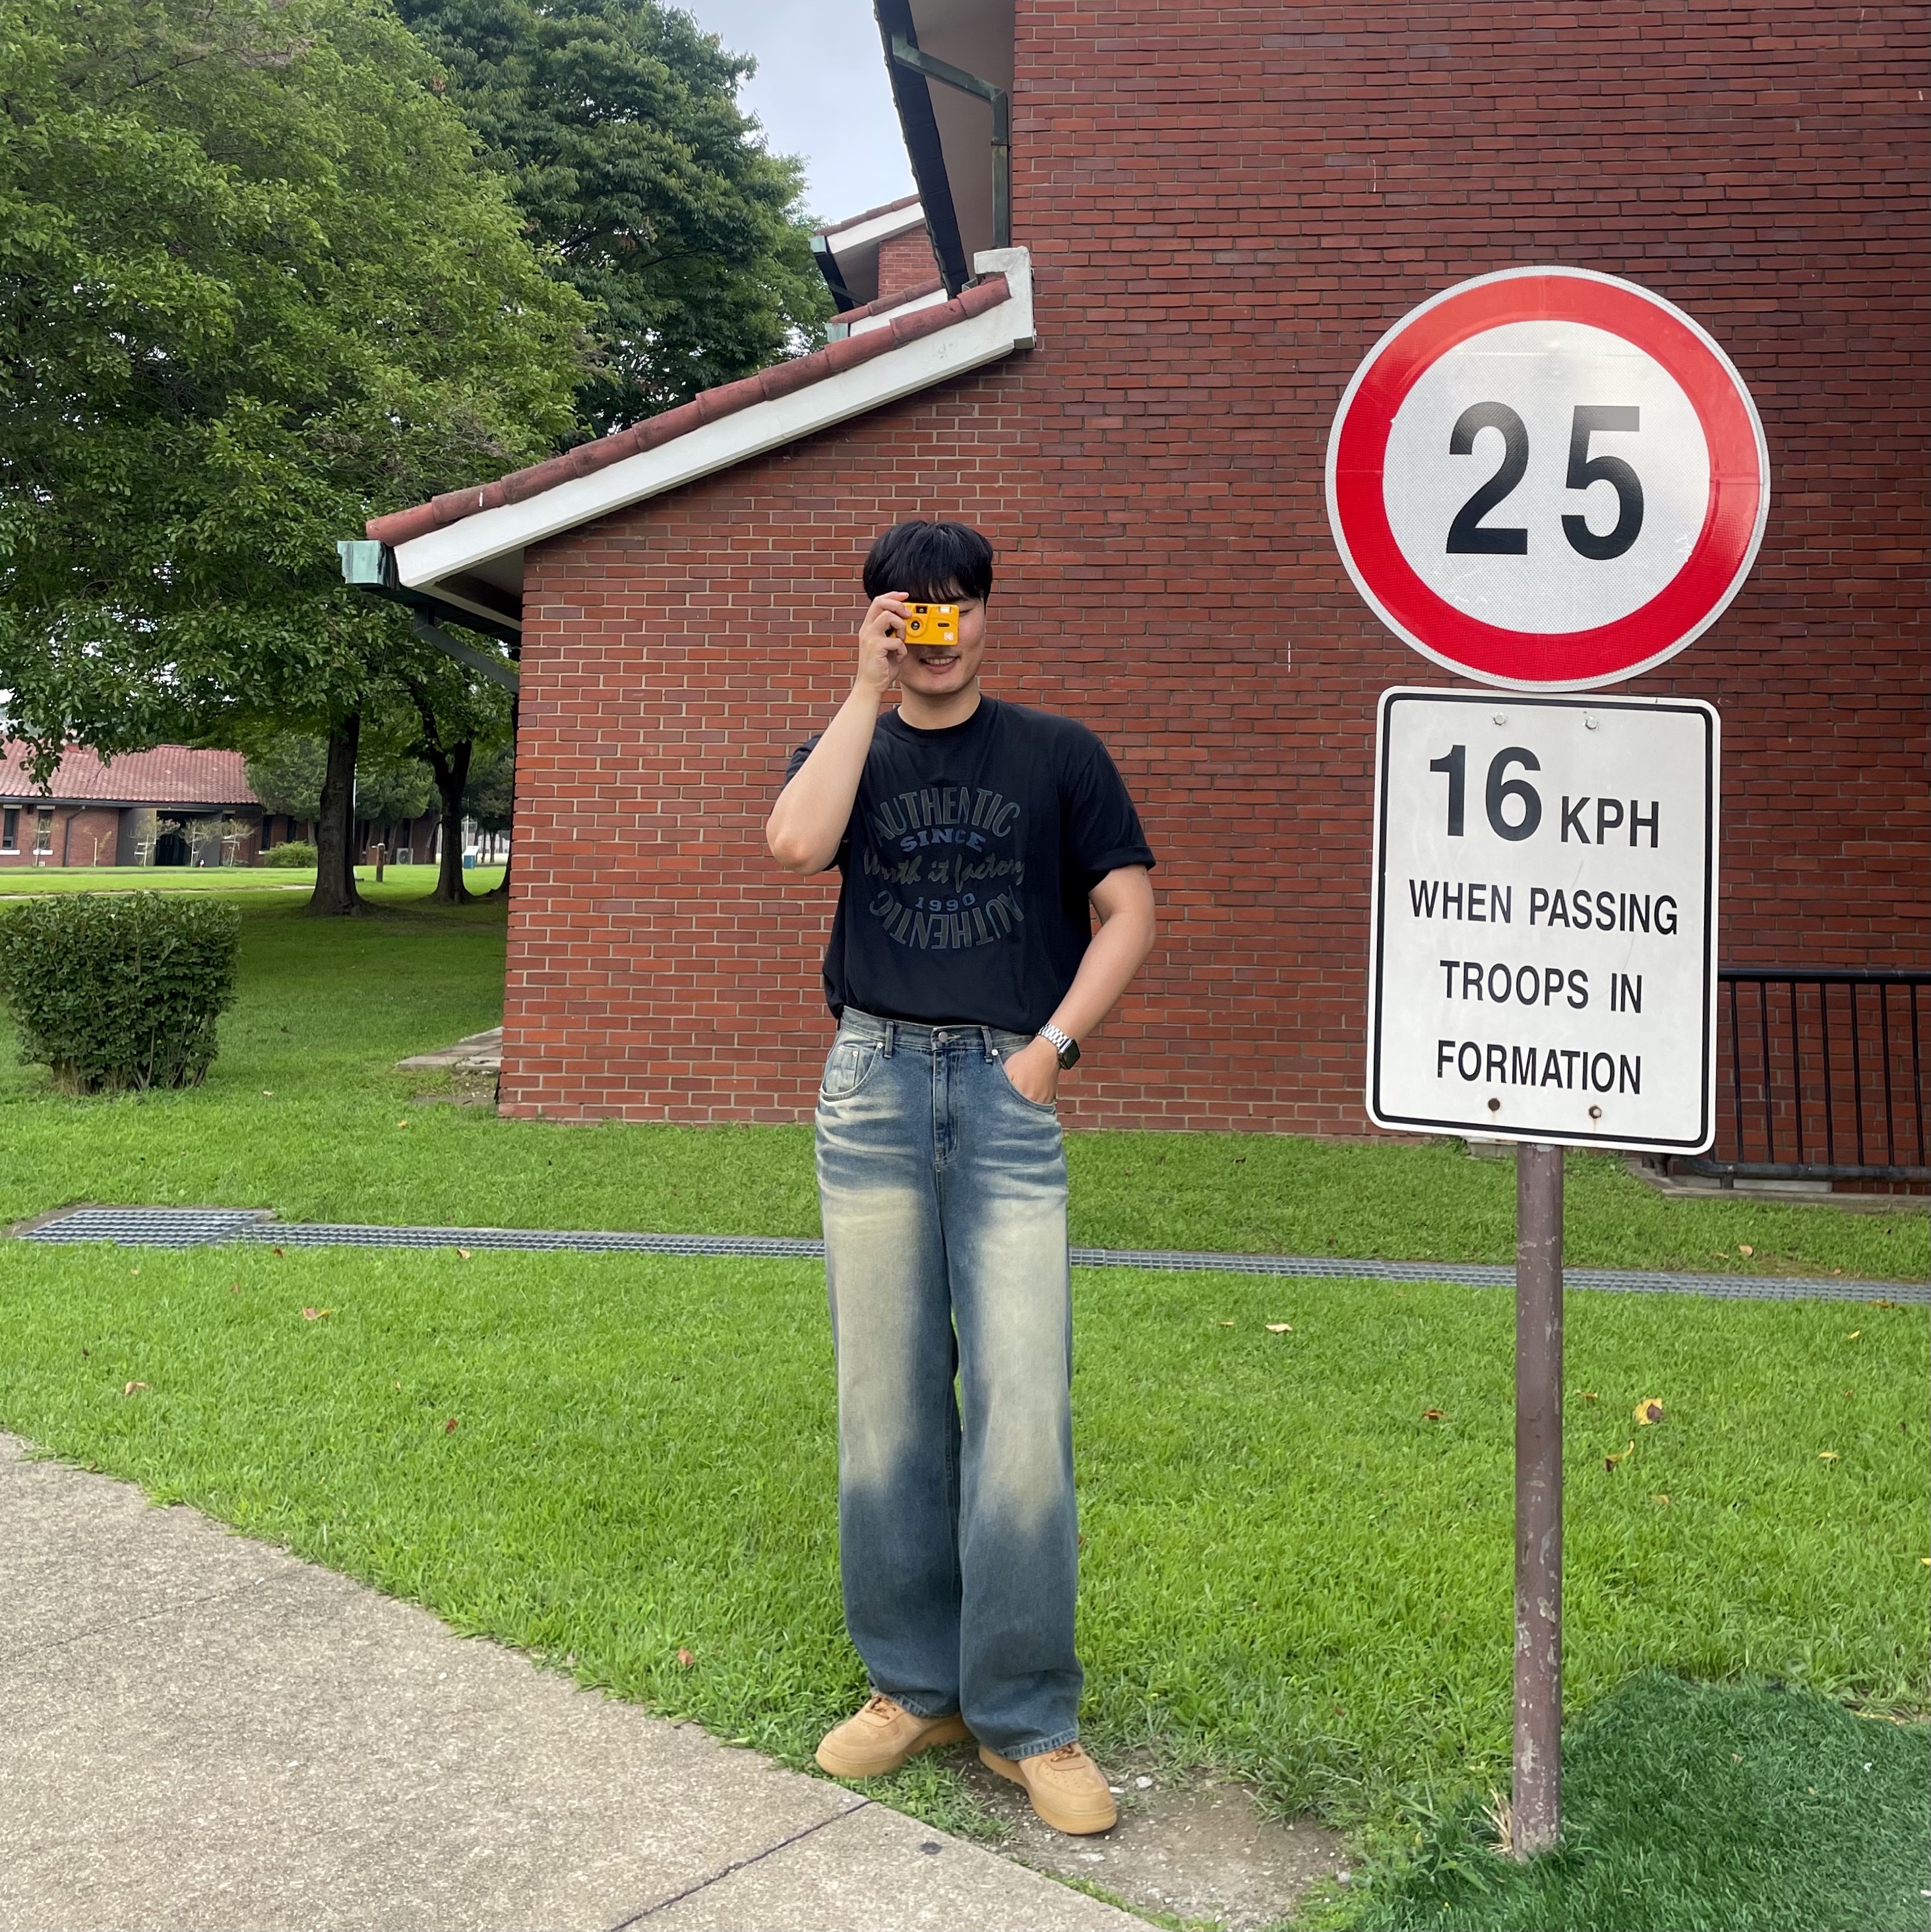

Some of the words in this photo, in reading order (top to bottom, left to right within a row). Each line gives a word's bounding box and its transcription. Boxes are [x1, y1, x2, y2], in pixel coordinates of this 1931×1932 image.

[1446, 401, 1644, 560] 25
[867, 786, 1020, 847] AUTHENTIC
[1430, 745, 1542, 841] 16
[1561, 795, 1659, 848] KPH
[900, 828, 987, 852] SINCE
[928, 860, 950, 884] it
[954, 854, 1025, 892] factory
[869, 885, 1024, 949] AUTHENTIC
[915, 893, 975, 912] 1990
[1409, 879, 1512, 923] WHEN
[1529, 887, 1678, 935] PASSING
[1440, 960, 1589, 1009] TROOPS
[1610, 973, 1643, 1013] IN
[1437, 1040, 1641, 1094] FORMATION
